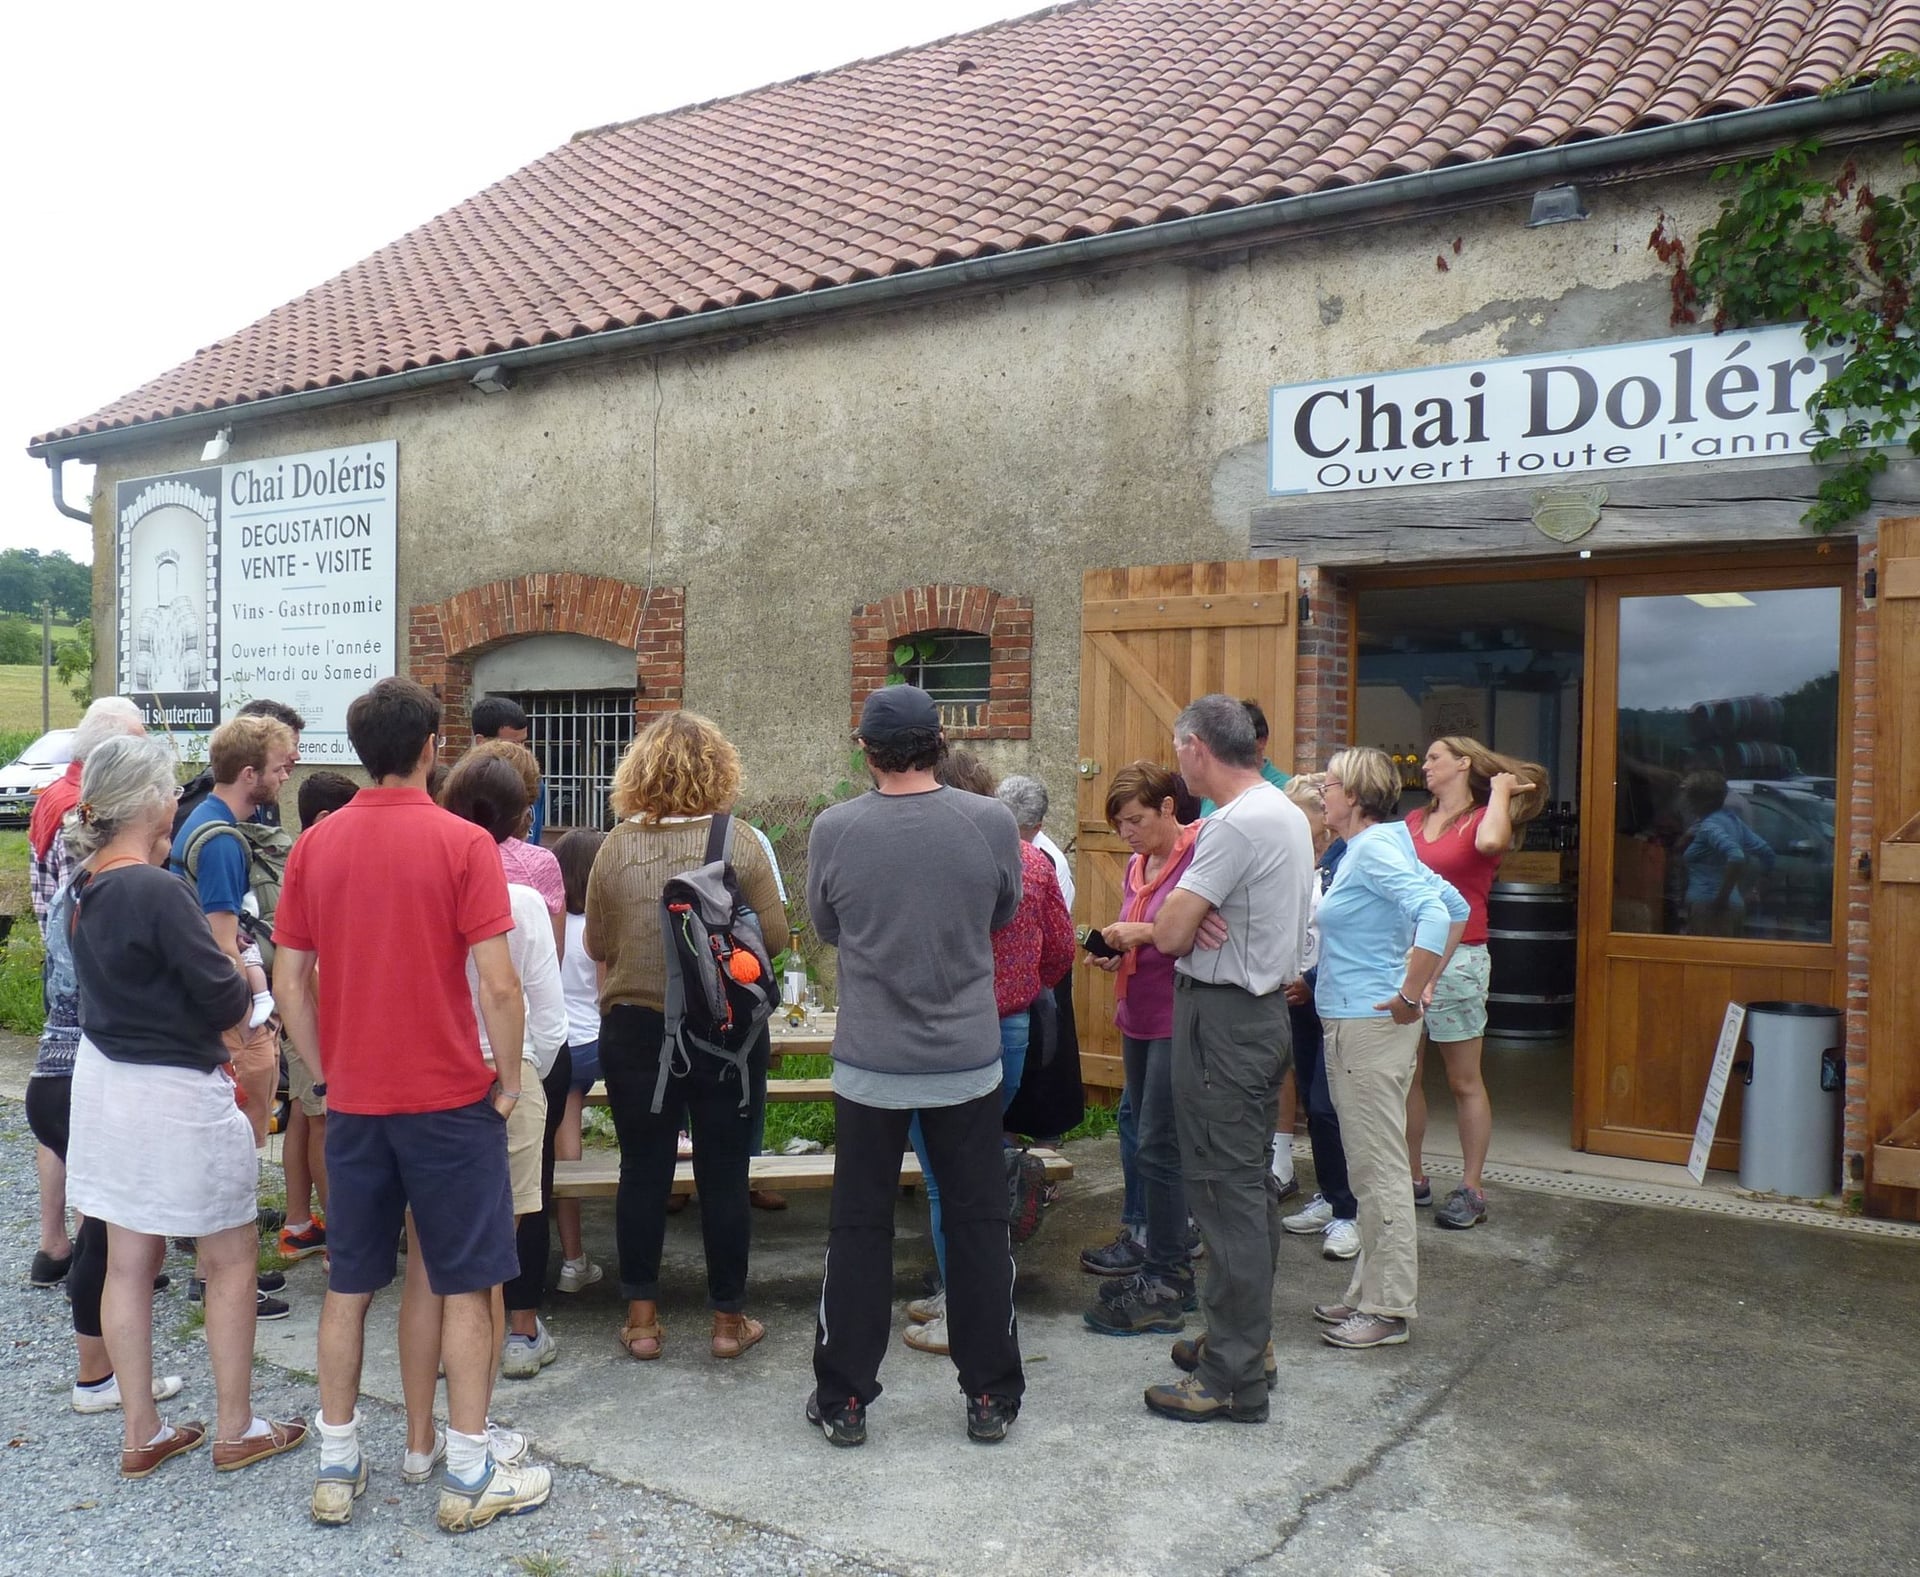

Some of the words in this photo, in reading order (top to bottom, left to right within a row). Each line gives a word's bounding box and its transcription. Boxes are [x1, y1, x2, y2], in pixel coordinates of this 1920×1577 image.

[1294, 371, 1490, 459] Chai
[1521, 332, 1908, 438] Doléri
[231, 464, 284, 506] Chai
[292, 452, 385, 498] Doléris
[1317, 454, 1473, 487] Ouvert
[1497, 443, 1631, 472] toute
[242, 513, 371, 548] DEGUSTATION
[241, 554, 296, 580] VENTE
[316, 547, 372, 574] VISITE
[232, 604, 264, 620] Vins
[279, 596, 383, 618] Gastronomie
[231, 643, 276, 659] Ouvert
[283, 642, 320, 656] toute
[326, 639, 382, 655] l'année
[235, 667, 251, 682] du
[256, 666, 295, 682] Mardi
[301, 669, 318, 680] au
[324, 664, 377, 680] Samedi
[152, 702, 214, 724] souterrain
[299, 742, 327, 754] erenc
[331, 738, 344, 754] du
